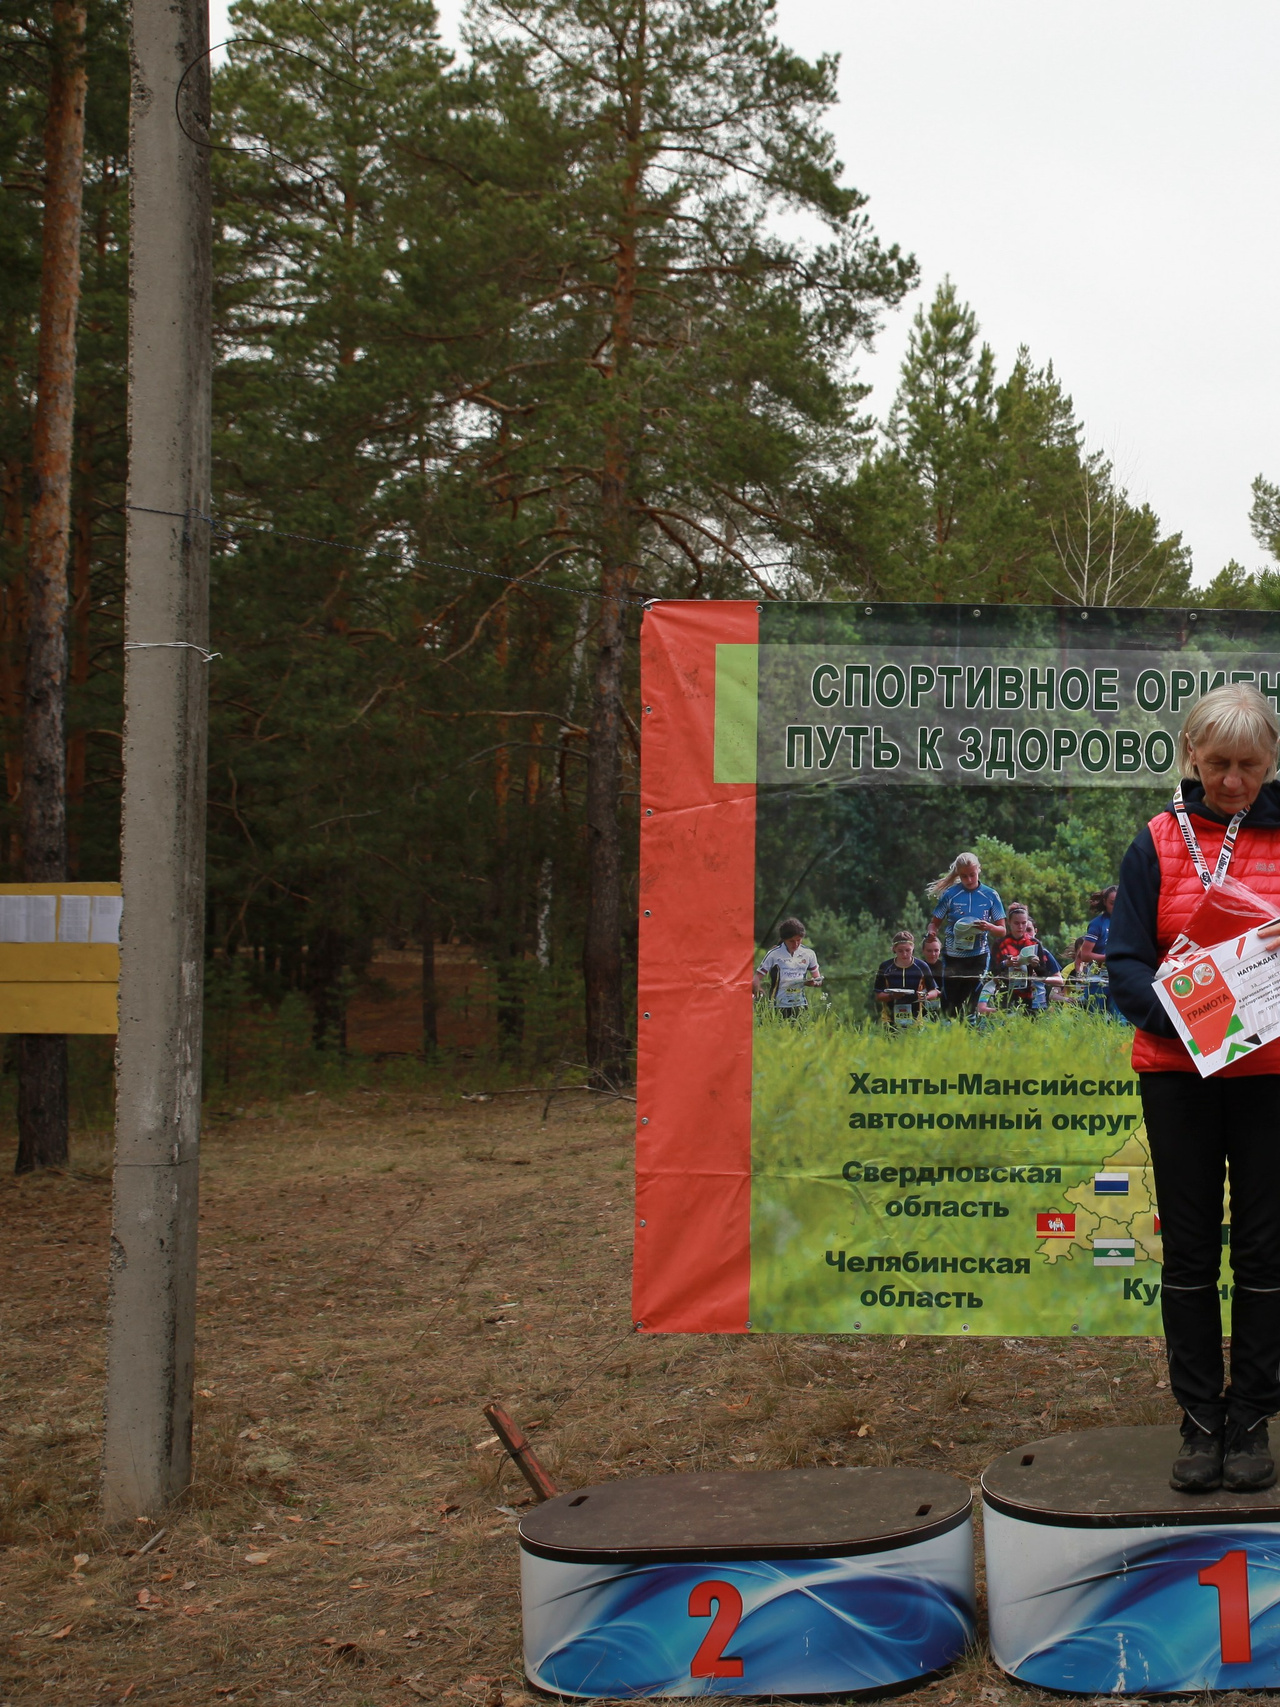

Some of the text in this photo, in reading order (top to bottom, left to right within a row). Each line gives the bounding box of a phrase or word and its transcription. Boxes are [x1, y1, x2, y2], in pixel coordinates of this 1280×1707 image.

[812, 663, 1119, 711] СПОРТИВНОЕ
[786, 725, 901, 770] ПУТЬ
[918, 726, 943, 770] К
[958, 726, 1175, 779] ЗДОРОВО
[1237, 953, 1279, 977] НАГРАЖДАЕТ
[1186, 993, 1230, 1021] ГРАМОТА
[849, 1108, 1137, 1136] автономный округ
[842, 1161, 1061, 1187] Свердловская
[885, 1195, 1009, 1218] область
[825, 1251, 1031, 1274] Челябинская
[860, 1285, 983, 1308] область
[1198, 1549, 1252, 1664] 1
[688, 1579, 744, 1679] 2
